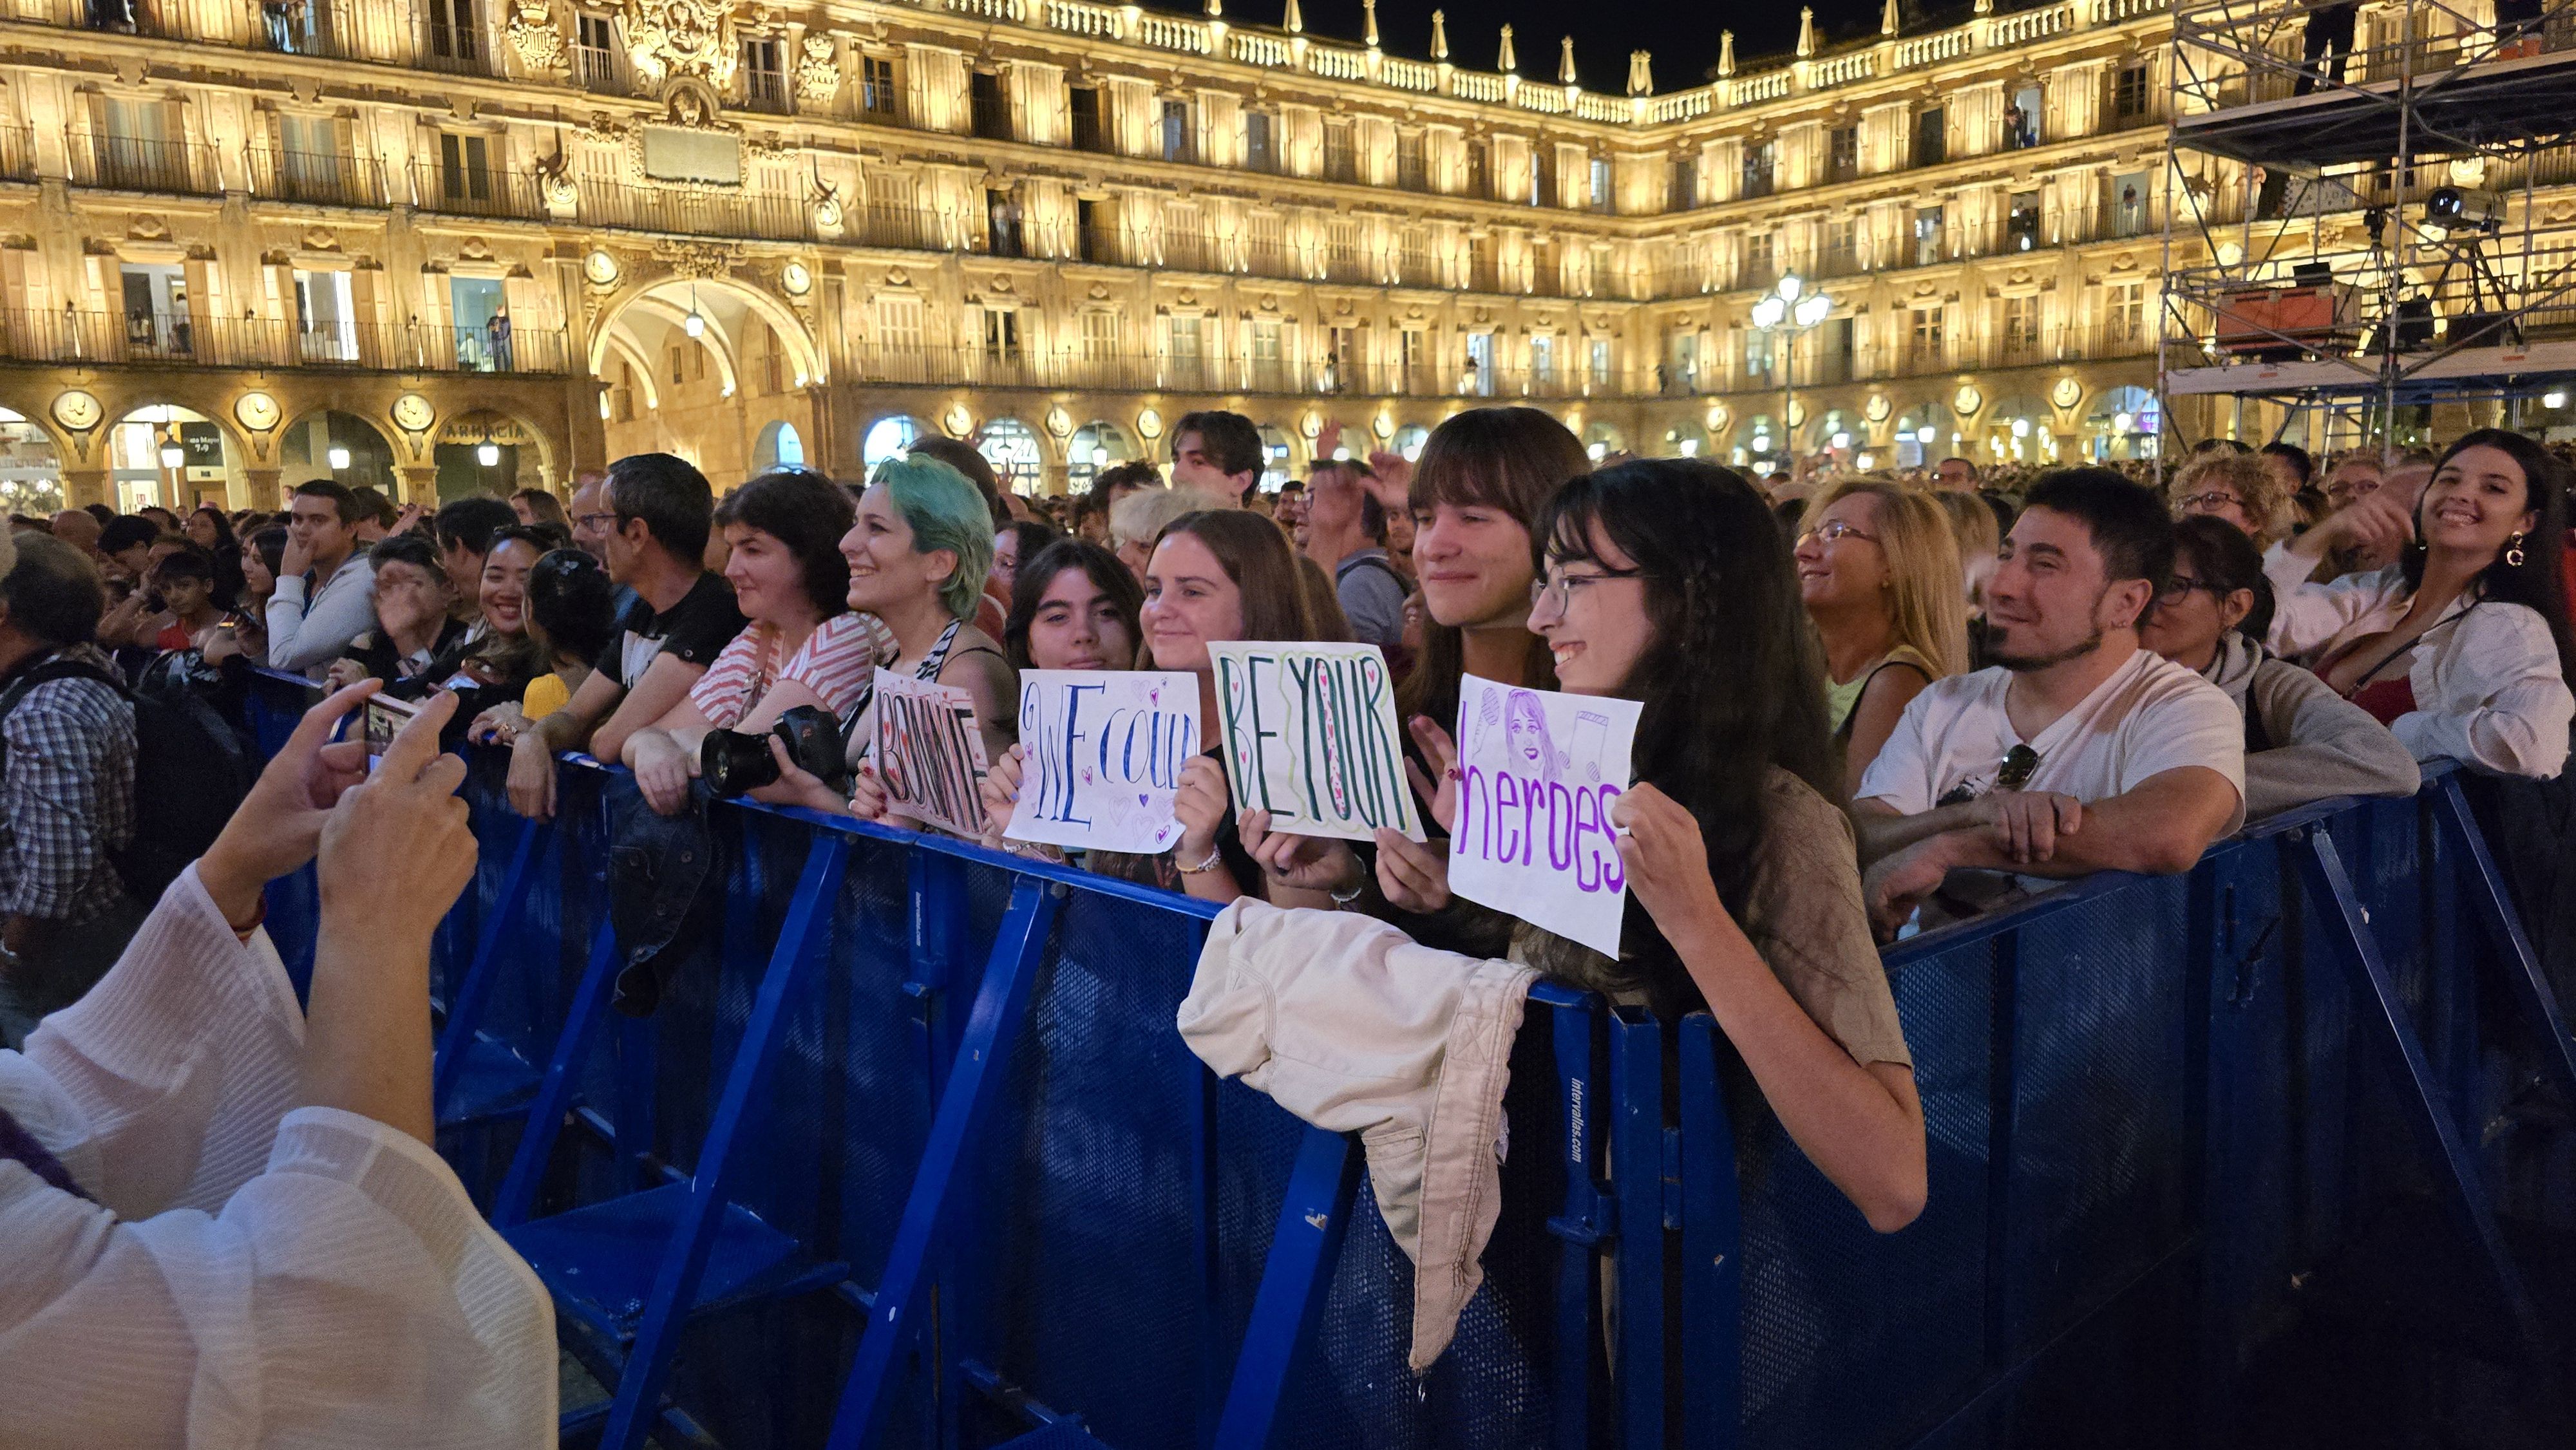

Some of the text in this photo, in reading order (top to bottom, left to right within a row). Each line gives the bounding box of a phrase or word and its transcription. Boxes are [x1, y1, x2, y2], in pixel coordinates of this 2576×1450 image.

[446, 426, 524, 438] ARMACIA
[1023, 680, 1106, 832] WE
[1220, 655, 1406, 831] BE YOUR
[1456, 701, 1625, 894] heroes
[1571, 1077, 1584, 1163] intervallas.com
